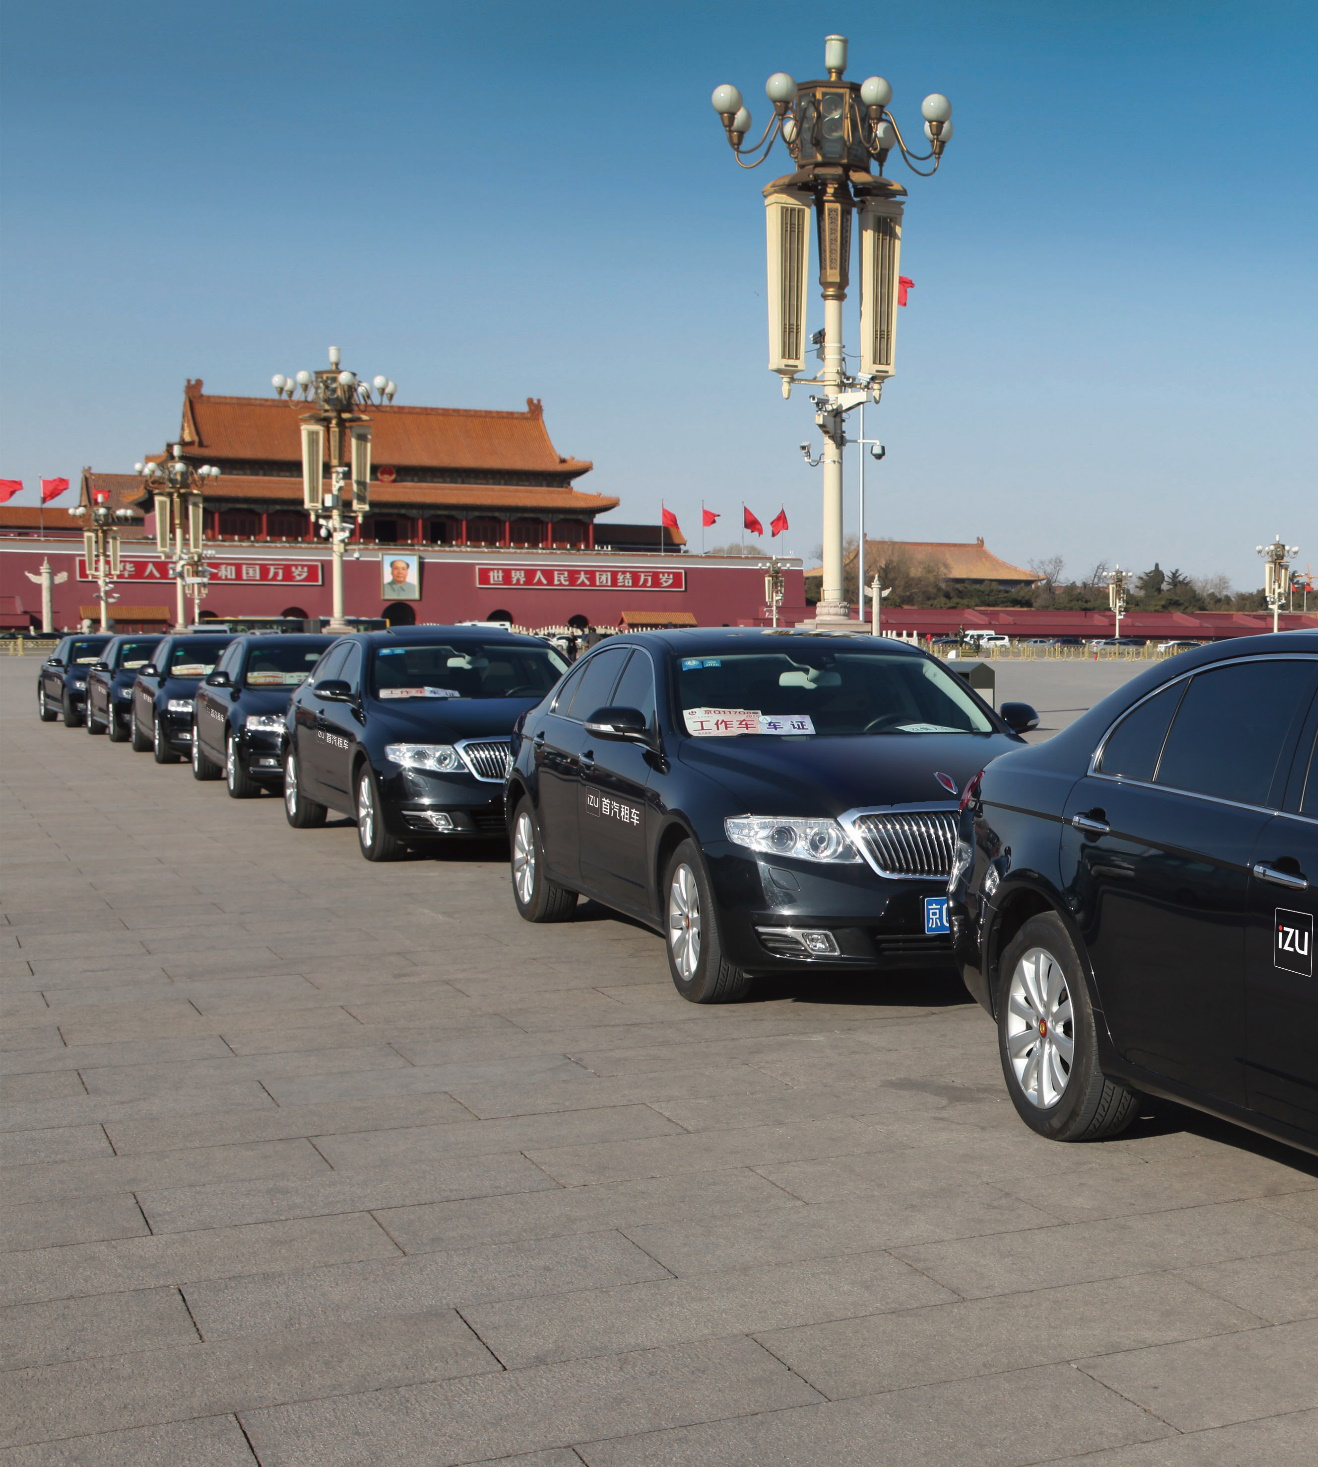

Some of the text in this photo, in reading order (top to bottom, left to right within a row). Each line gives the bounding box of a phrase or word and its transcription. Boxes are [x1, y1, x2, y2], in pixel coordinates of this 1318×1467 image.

[93, 561, 309, 581] 中华人和国万岁
[488, 569, 674, 587] 世界人民大团结万岁
[693, 719, 757, 731] 工作车
[767, 721, 809, 731] 车证
[601, 797, 640, 826] 首汽租车
[1278, 924, 1309, 956] iZU
